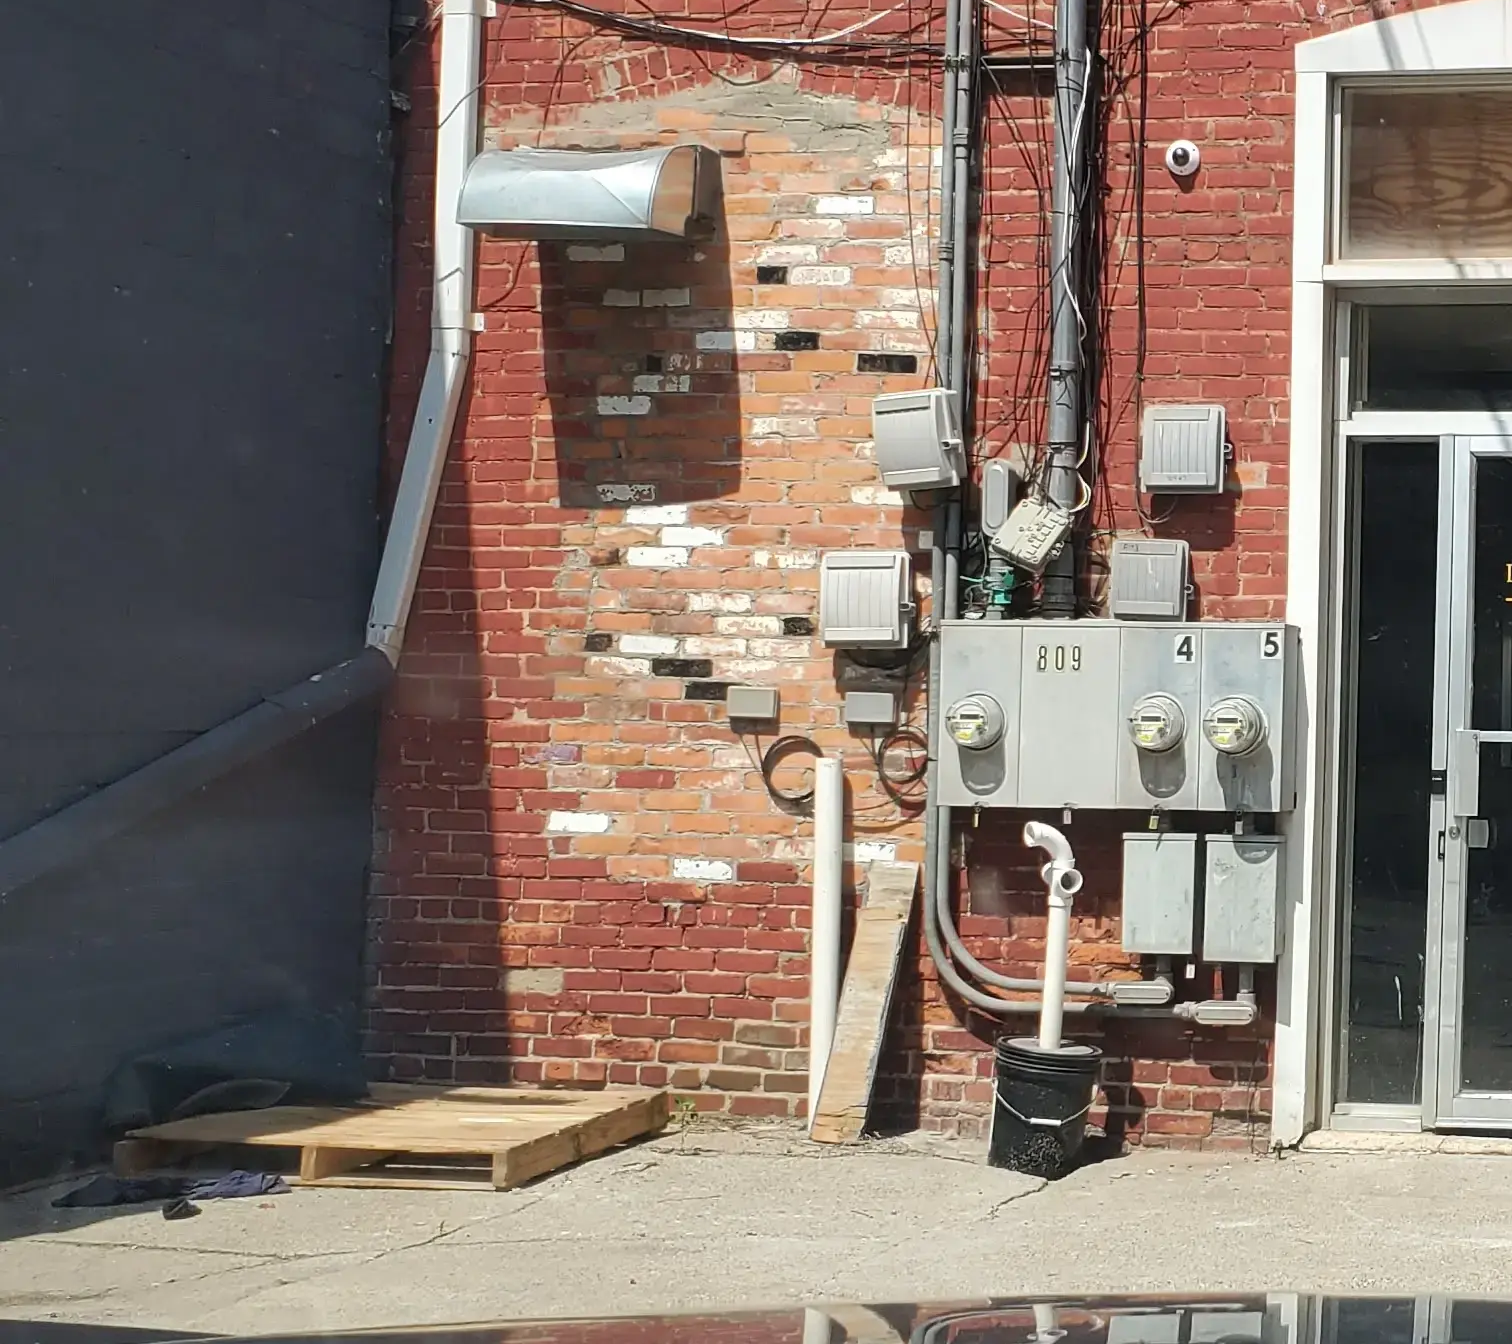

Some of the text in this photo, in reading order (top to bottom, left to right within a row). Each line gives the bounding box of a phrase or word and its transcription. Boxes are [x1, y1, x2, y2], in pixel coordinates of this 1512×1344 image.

[1037, 645, 1082, 672] 809
[1176, 635, 1194, 662] 4
[1263, 632, 1279, 658] 5
